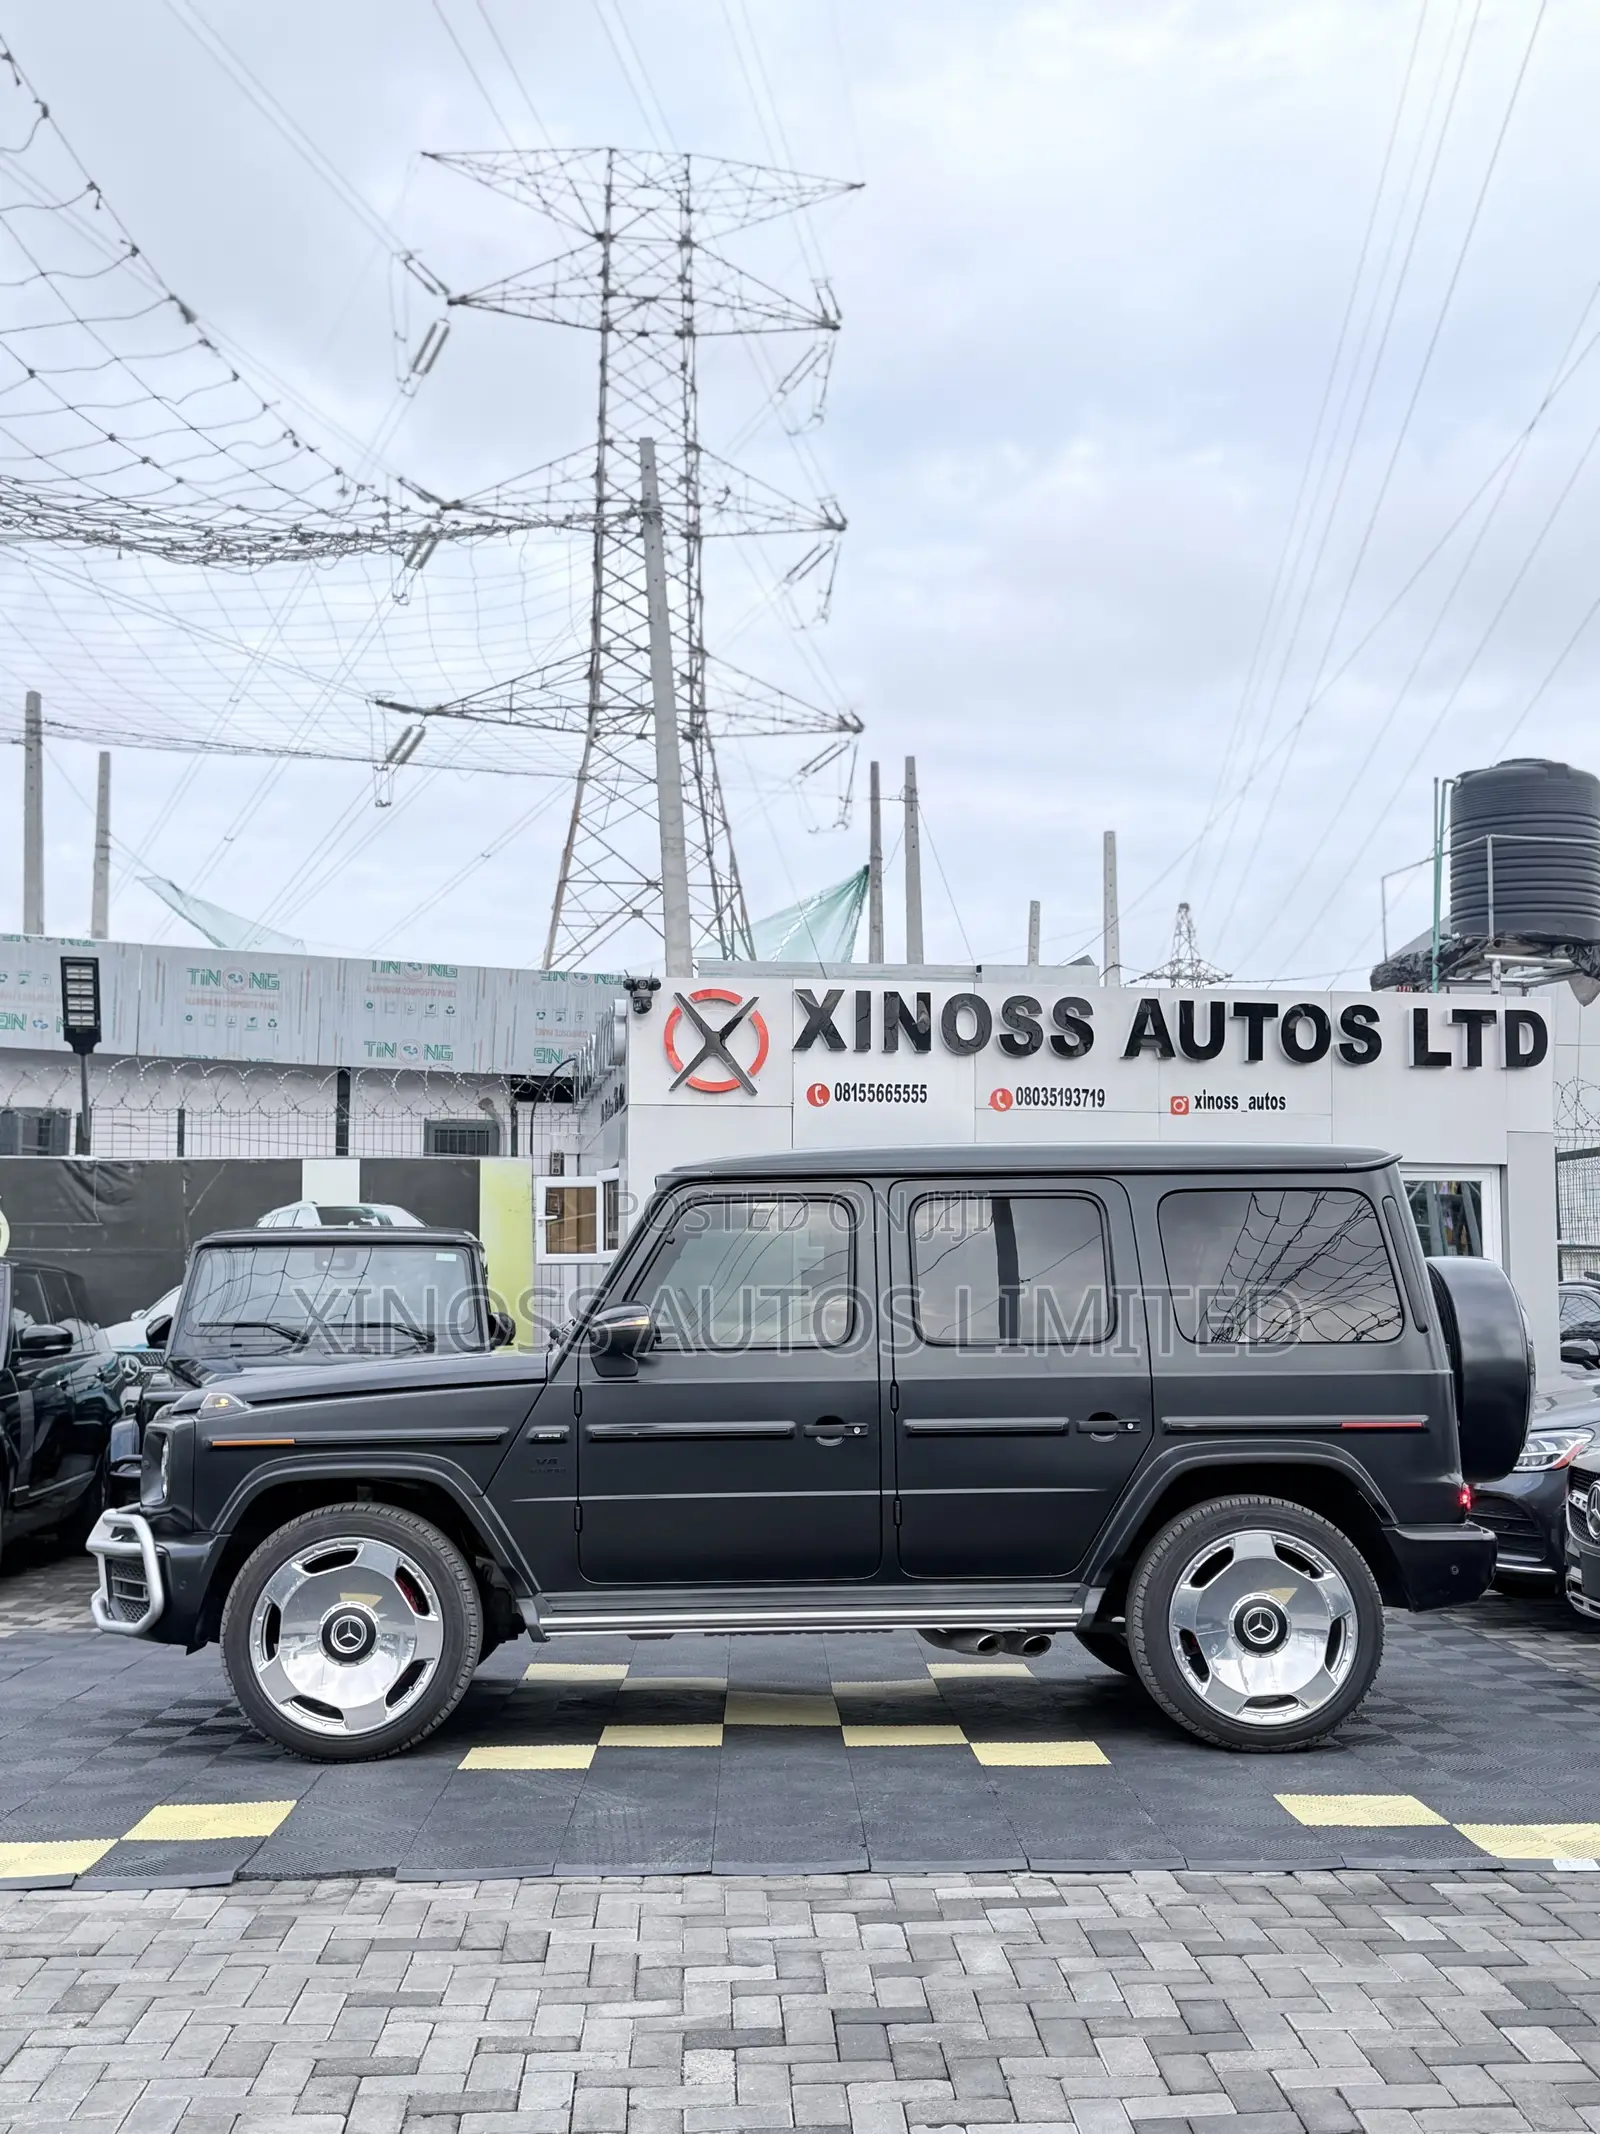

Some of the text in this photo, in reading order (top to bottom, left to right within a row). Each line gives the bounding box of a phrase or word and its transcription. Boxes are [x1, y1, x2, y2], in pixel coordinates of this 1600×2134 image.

[792, 988, 1549, 1069] XINOSS AUTOS LTD
[833, 1082, 929, 1104] 08155665555
[1015, 1087, 1106, 1109] 08035193719
